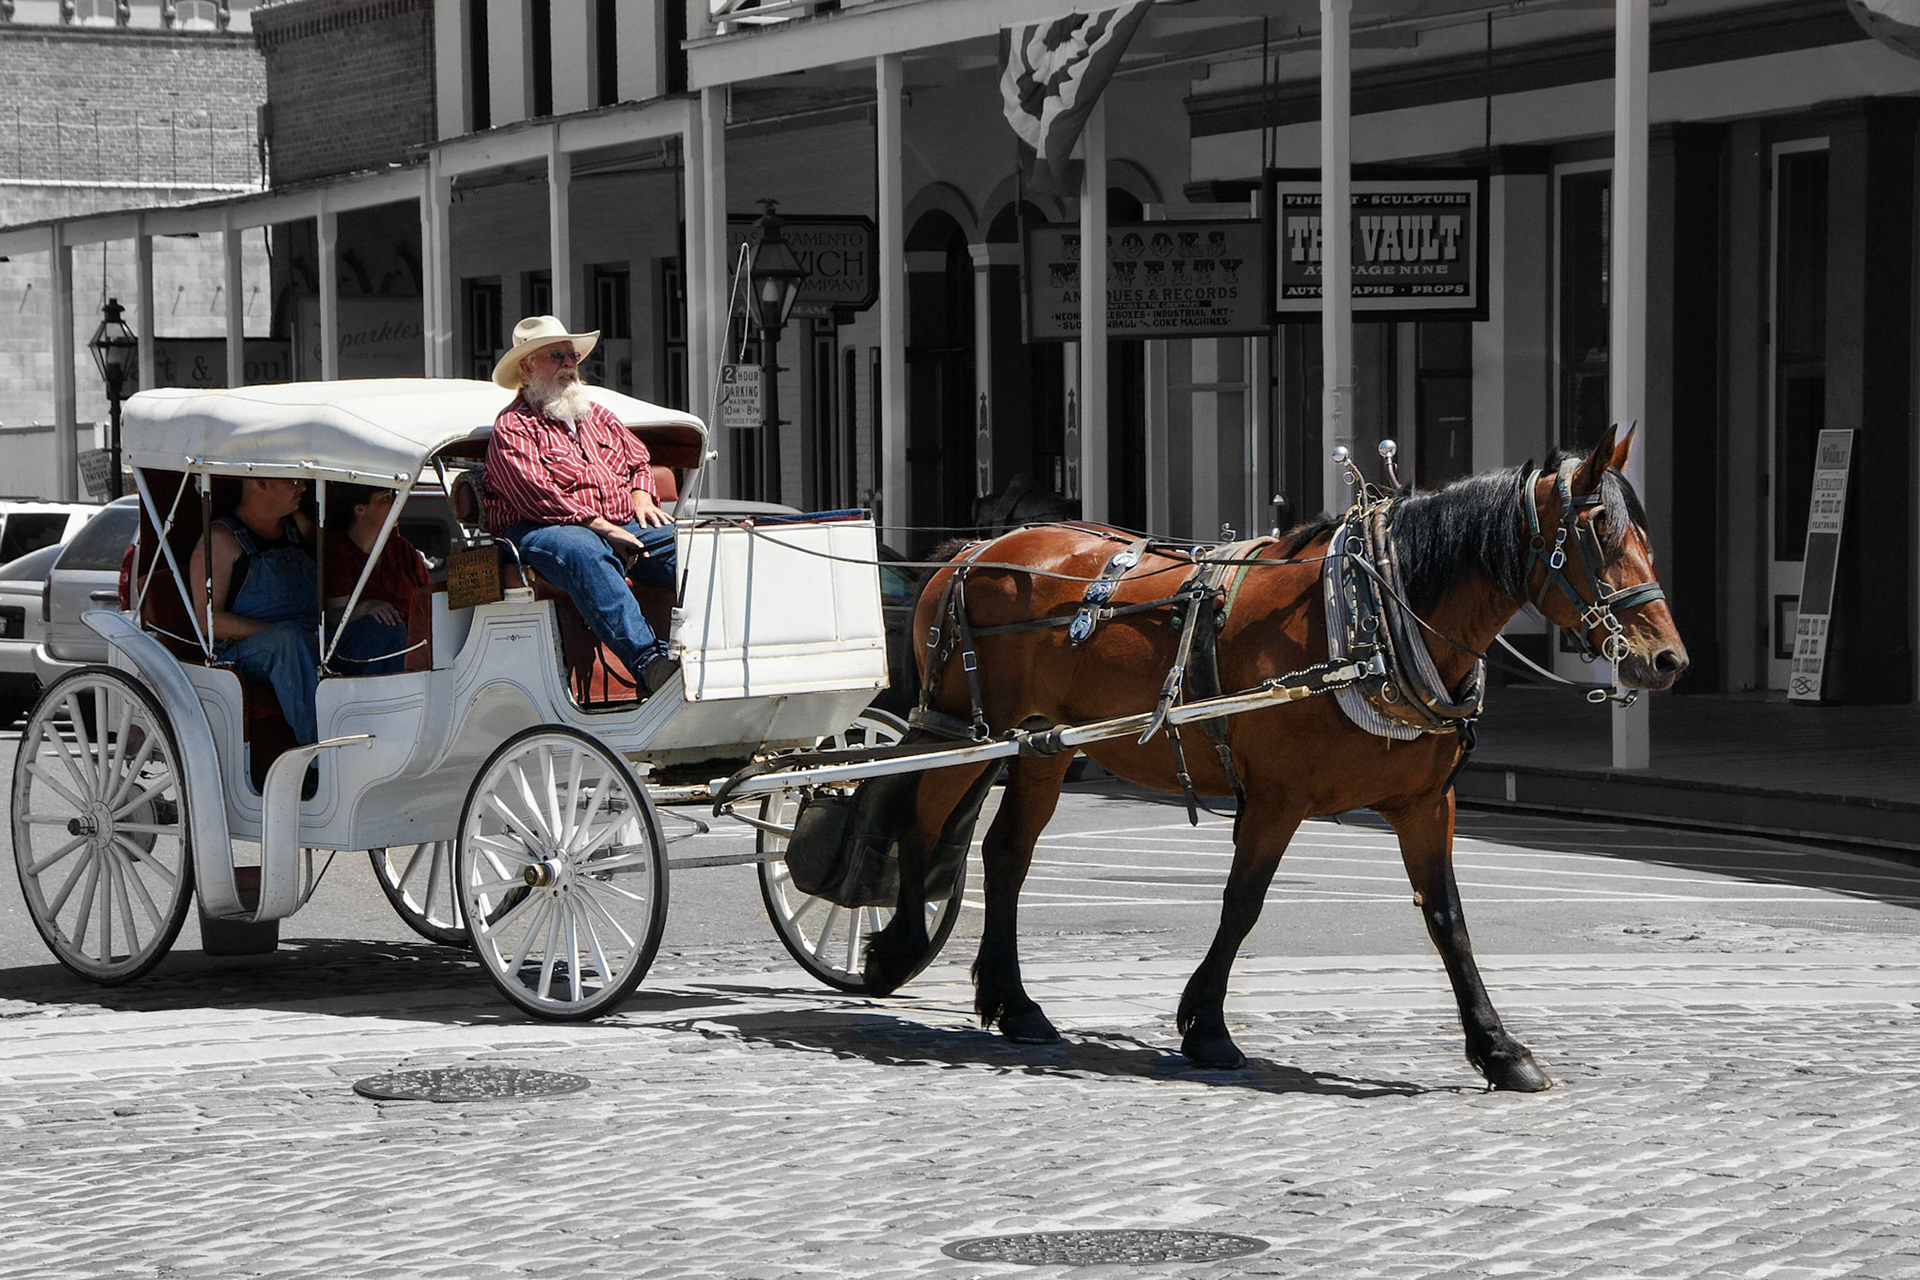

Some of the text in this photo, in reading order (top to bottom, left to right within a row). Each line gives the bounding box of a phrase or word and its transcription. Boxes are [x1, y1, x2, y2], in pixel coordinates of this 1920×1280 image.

[1286, 196, 1322, 205] FINE
[1371, 195, 1466, 205] SCULPTURE
[1288, 215, 1461, 262] TH VAULT
[1061, 231, 1227, 260] BOOKS
[1049, 259, 1243, 288] NVELTY
[1400, 265, 1449, 275] NINE
[1148, 289, 1159, 301] &
[1163, 287, 1238, 301] RECORDS
[1411, 285, 1465, 294] PROPS
[1153, 309, 1207, 318] INDUSTRIAL
[1211, 308, 1229, 317] ART
[1153, 318, 1177, 328] COKE
[1181, 317, 1228, 327] MACHINES
[191, 356, 211, 381] &
[244, 351, 290, 382] oul
[725, 367, 759, 381] 2 HOUR
[725, 386, 759, 398] PARKING
